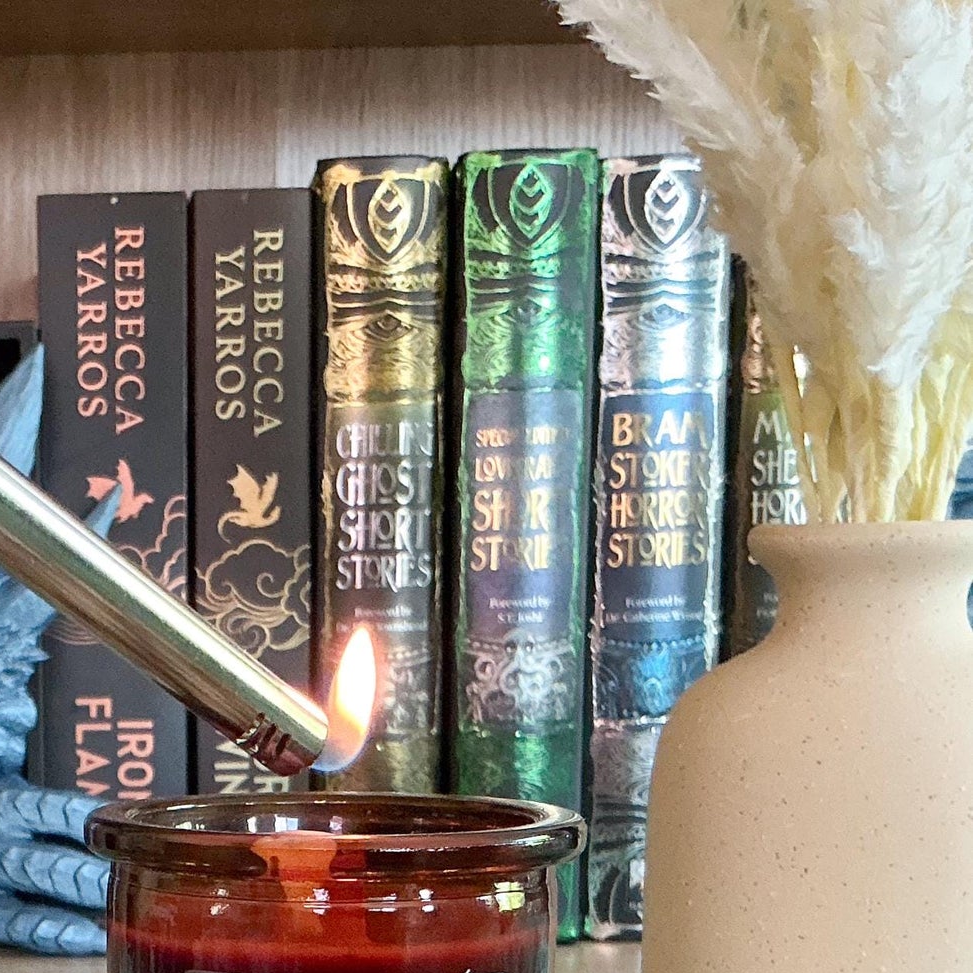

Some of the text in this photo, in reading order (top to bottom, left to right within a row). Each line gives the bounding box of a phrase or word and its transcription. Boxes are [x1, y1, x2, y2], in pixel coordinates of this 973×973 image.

[76, 241, 108, 418] YARROS
[114, 225, 146, 435] REBECCA
[215, 244, 246, 420] YARROS
[253, 227, 284, 437] REBECCA
[612, 410, 710, 449] BRAM
[336, 459, 433, 507] GHOST
[338, 506, 432, 558] SHORT
[606, 531, 708, 569] STORIES
[335, 551, 432, 593] STORIES
[117, 720, 155, 799] IRO
